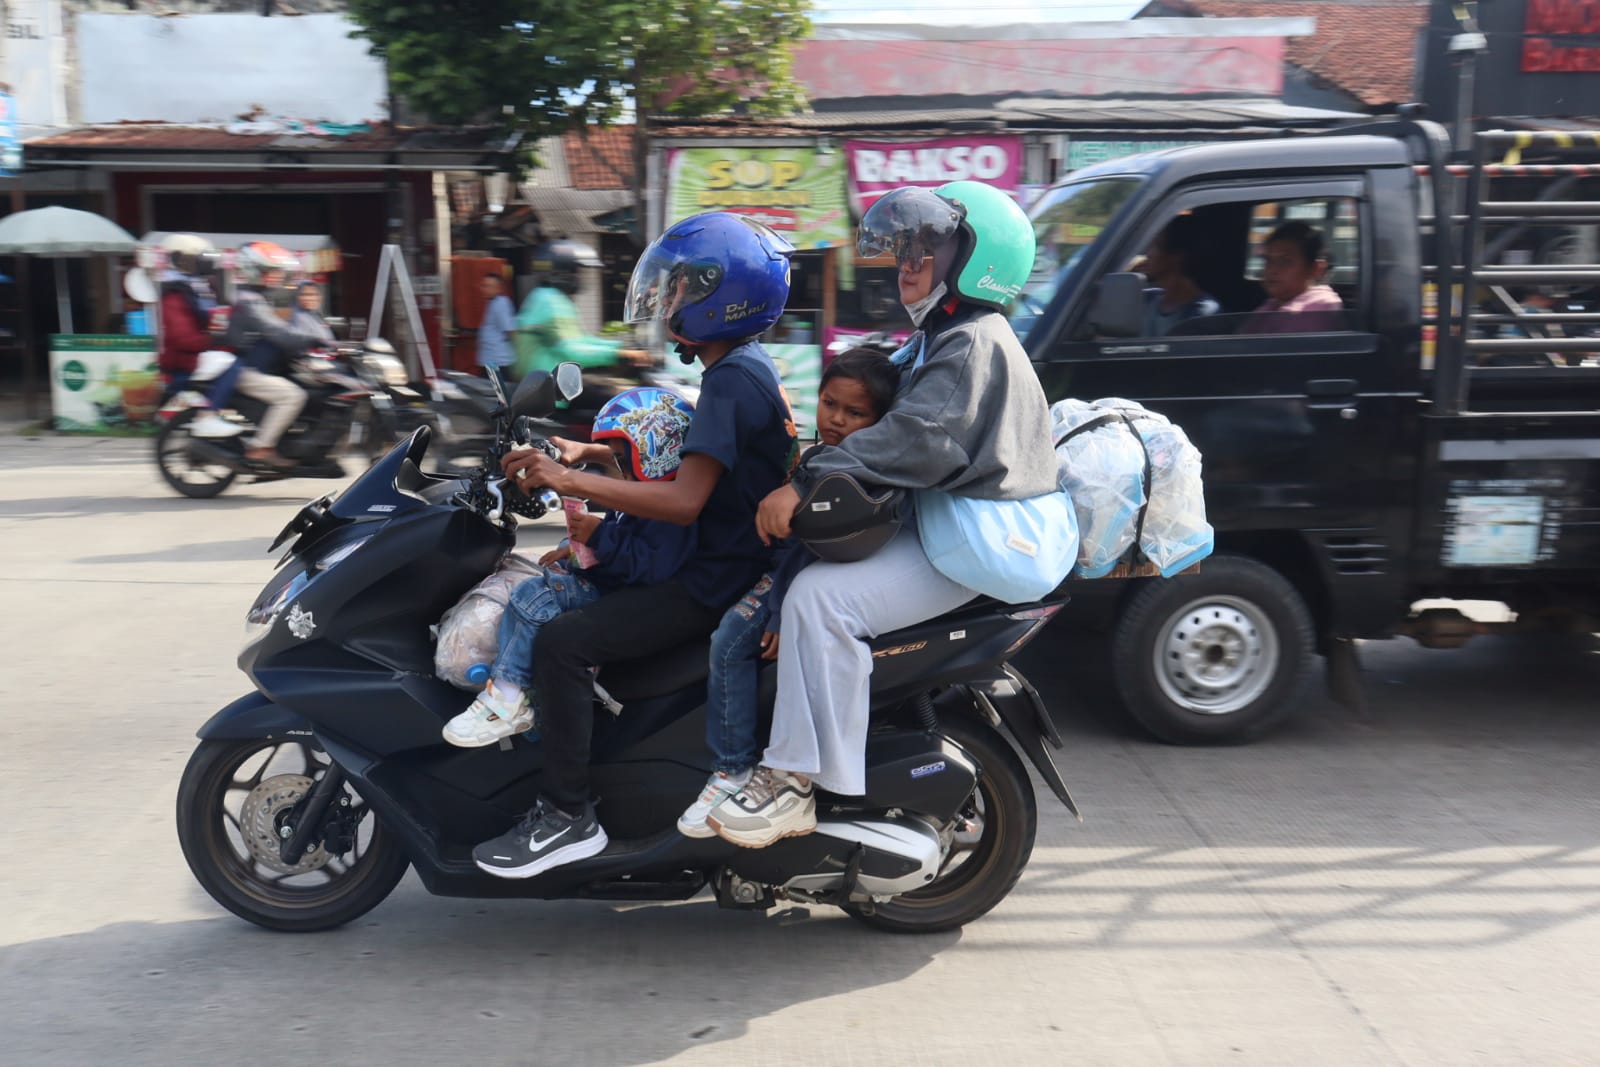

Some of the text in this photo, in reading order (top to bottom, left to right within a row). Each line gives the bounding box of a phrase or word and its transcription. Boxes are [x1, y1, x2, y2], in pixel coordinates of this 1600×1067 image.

[707, 159, 802, 191] SOP
[856, 146, 1007, 182] BAKSO
[726, 299, 748, 314] DJ
